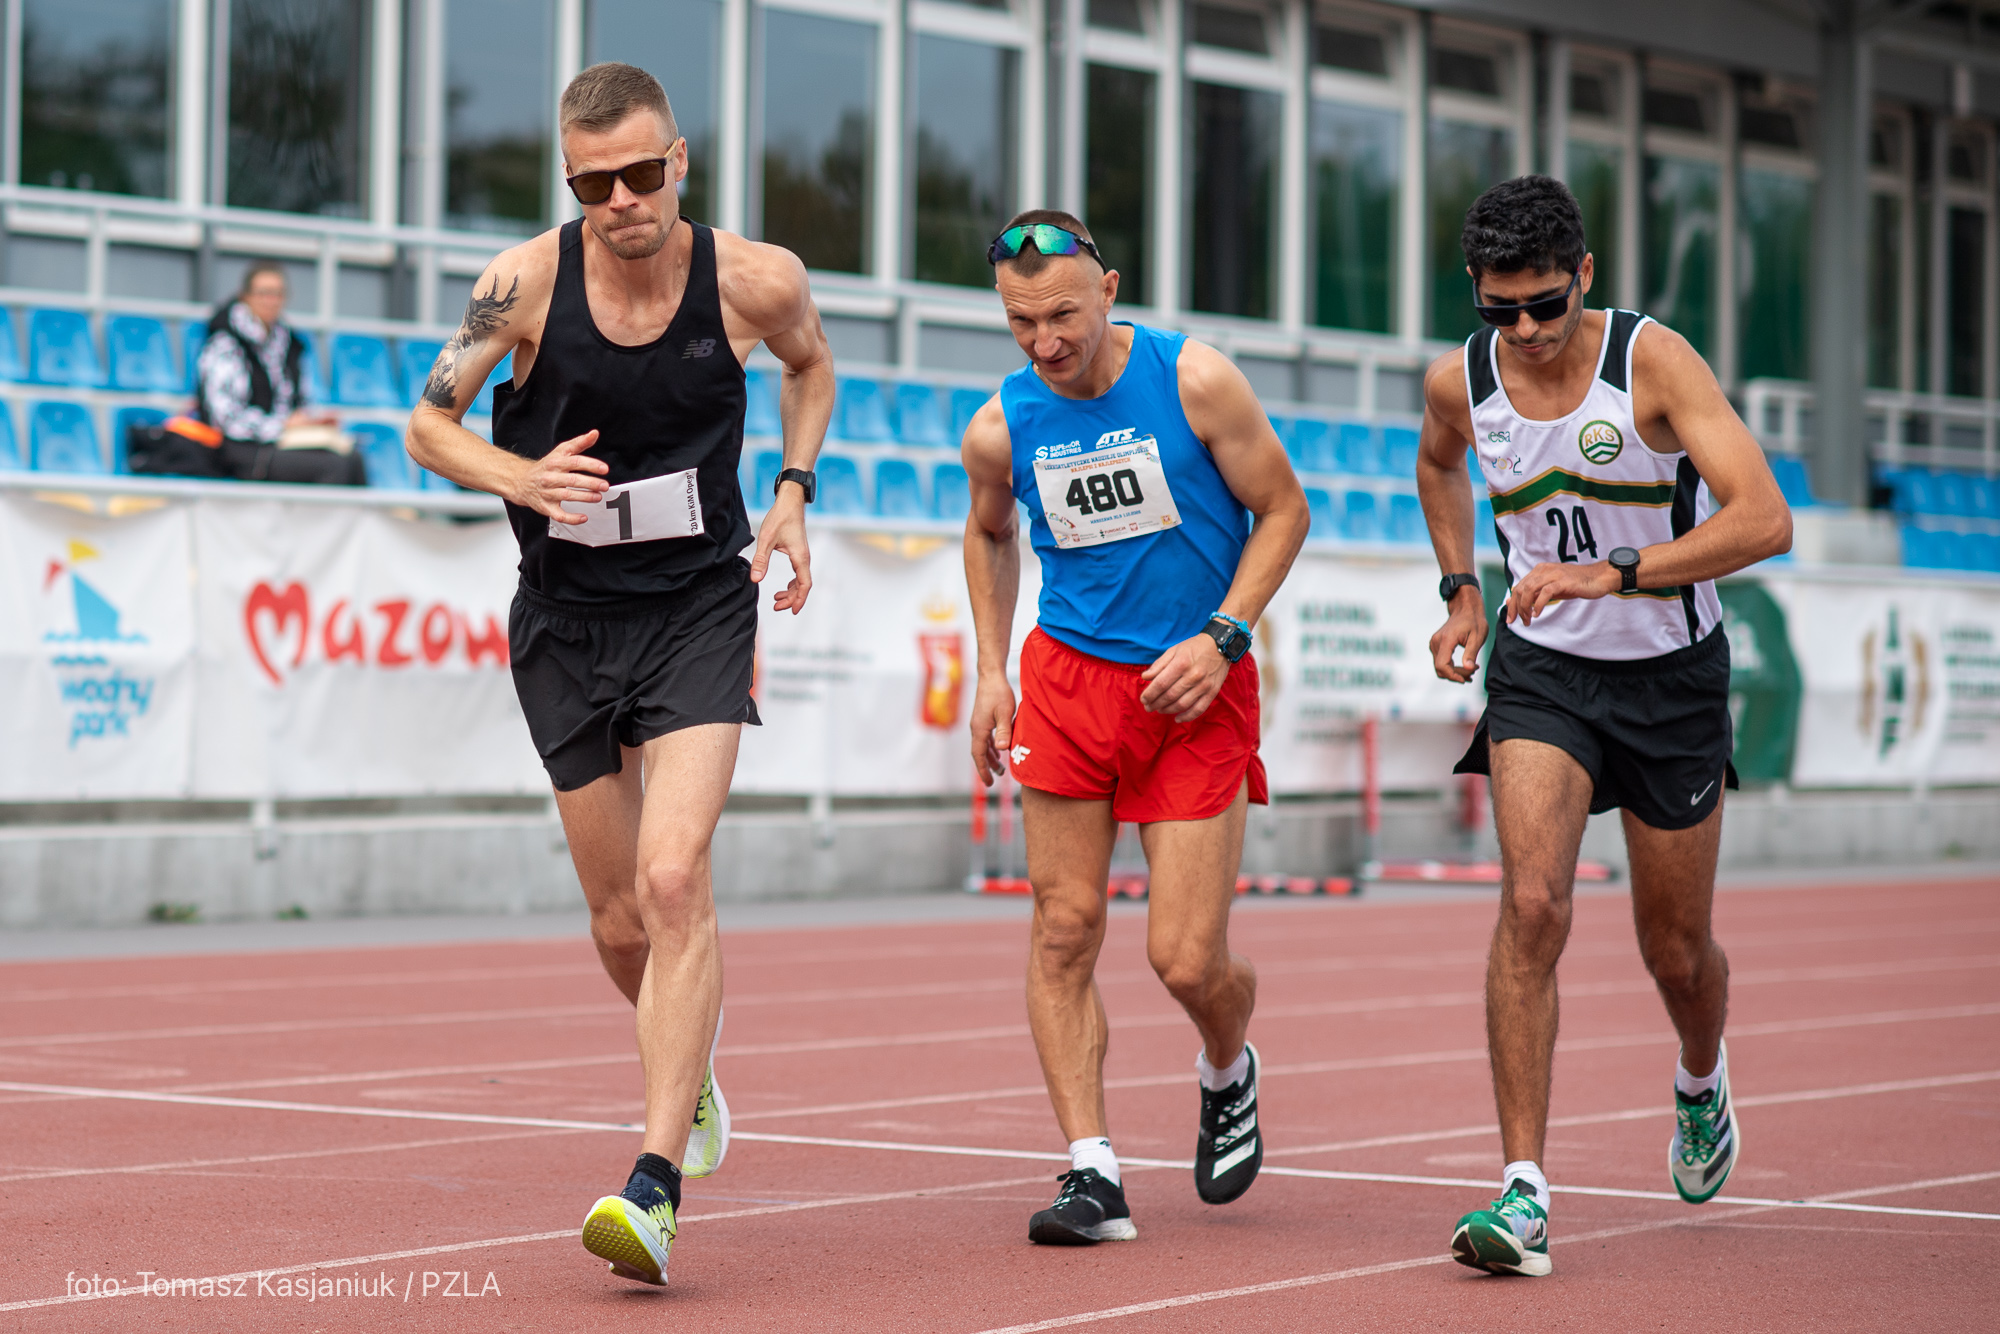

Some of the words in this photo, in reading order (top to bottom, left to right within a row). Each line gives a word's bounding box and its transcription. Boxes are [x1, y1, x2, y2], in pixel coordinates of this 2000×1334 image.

[1096, 427, 1136, 445] ATS
[1488, 431, 1511, 442] esa
[1584, 427, 1615, 447] RKS
[1050, 448, 1082, 459] INDUSTRIES
[1066, 468, 1144, 516] 480
[606, 490, 633, 541] 1
[689, 510, 697, 521] km
[1545, 505, 1598, 564] 24
[58, 669, 153, 715] wodny
[69, 710, 130, 750] park
